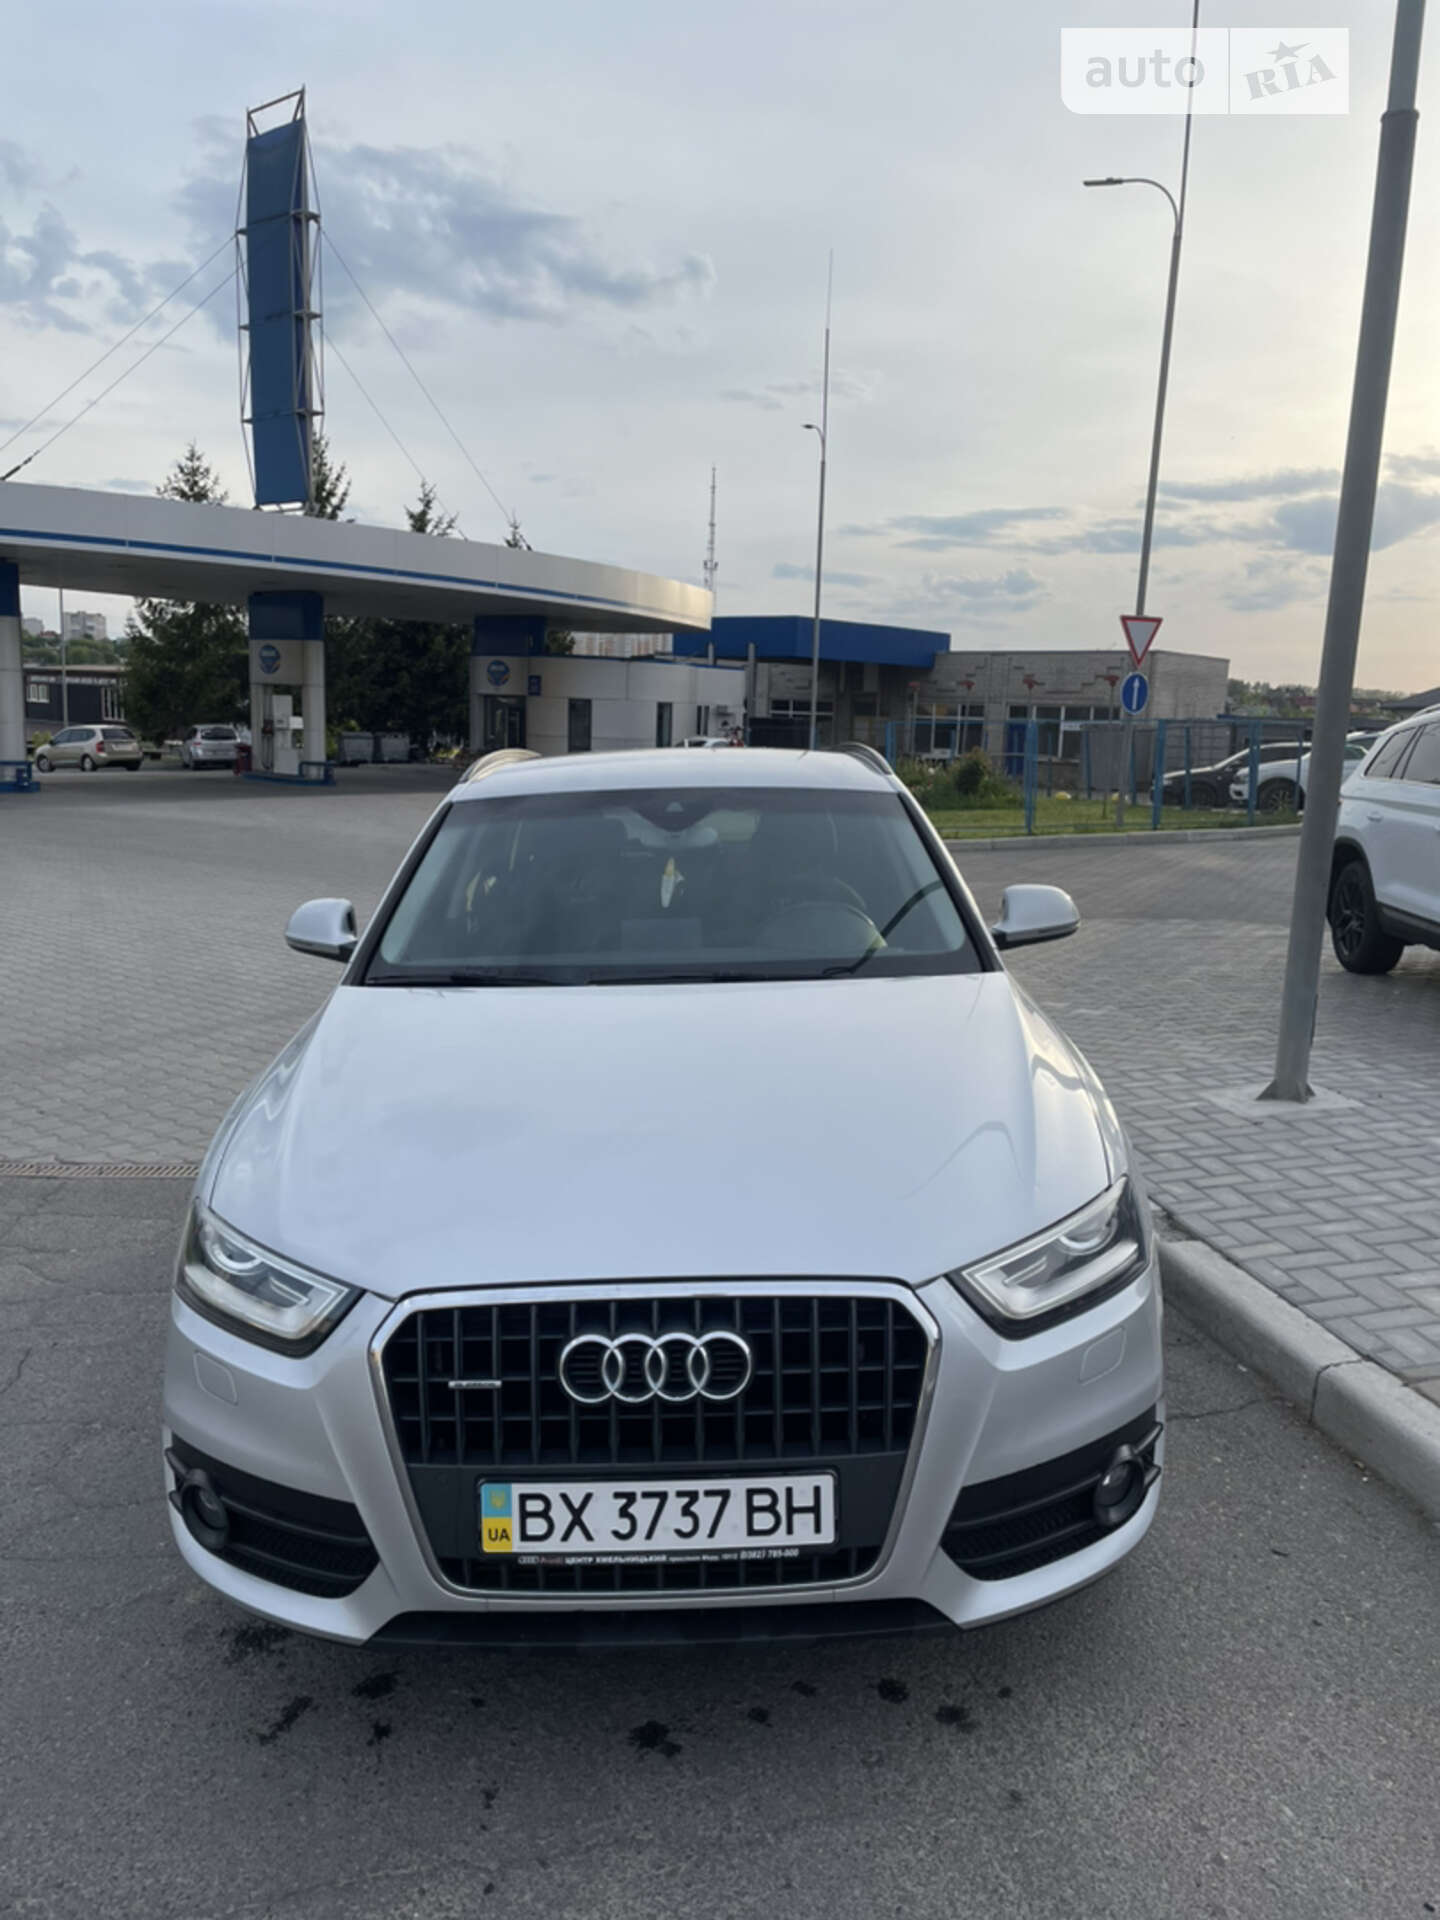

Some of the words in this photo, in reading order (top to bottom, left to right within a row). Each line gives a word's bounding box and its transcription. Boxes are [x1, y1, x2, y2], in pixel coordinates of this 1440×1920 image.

[518, 1492, 594, 1543] BX
[611, 1489, 732, 1541] 3737
[746, 1485, 822, 1537] BH
[488, 1528, 510, 1542] UA
